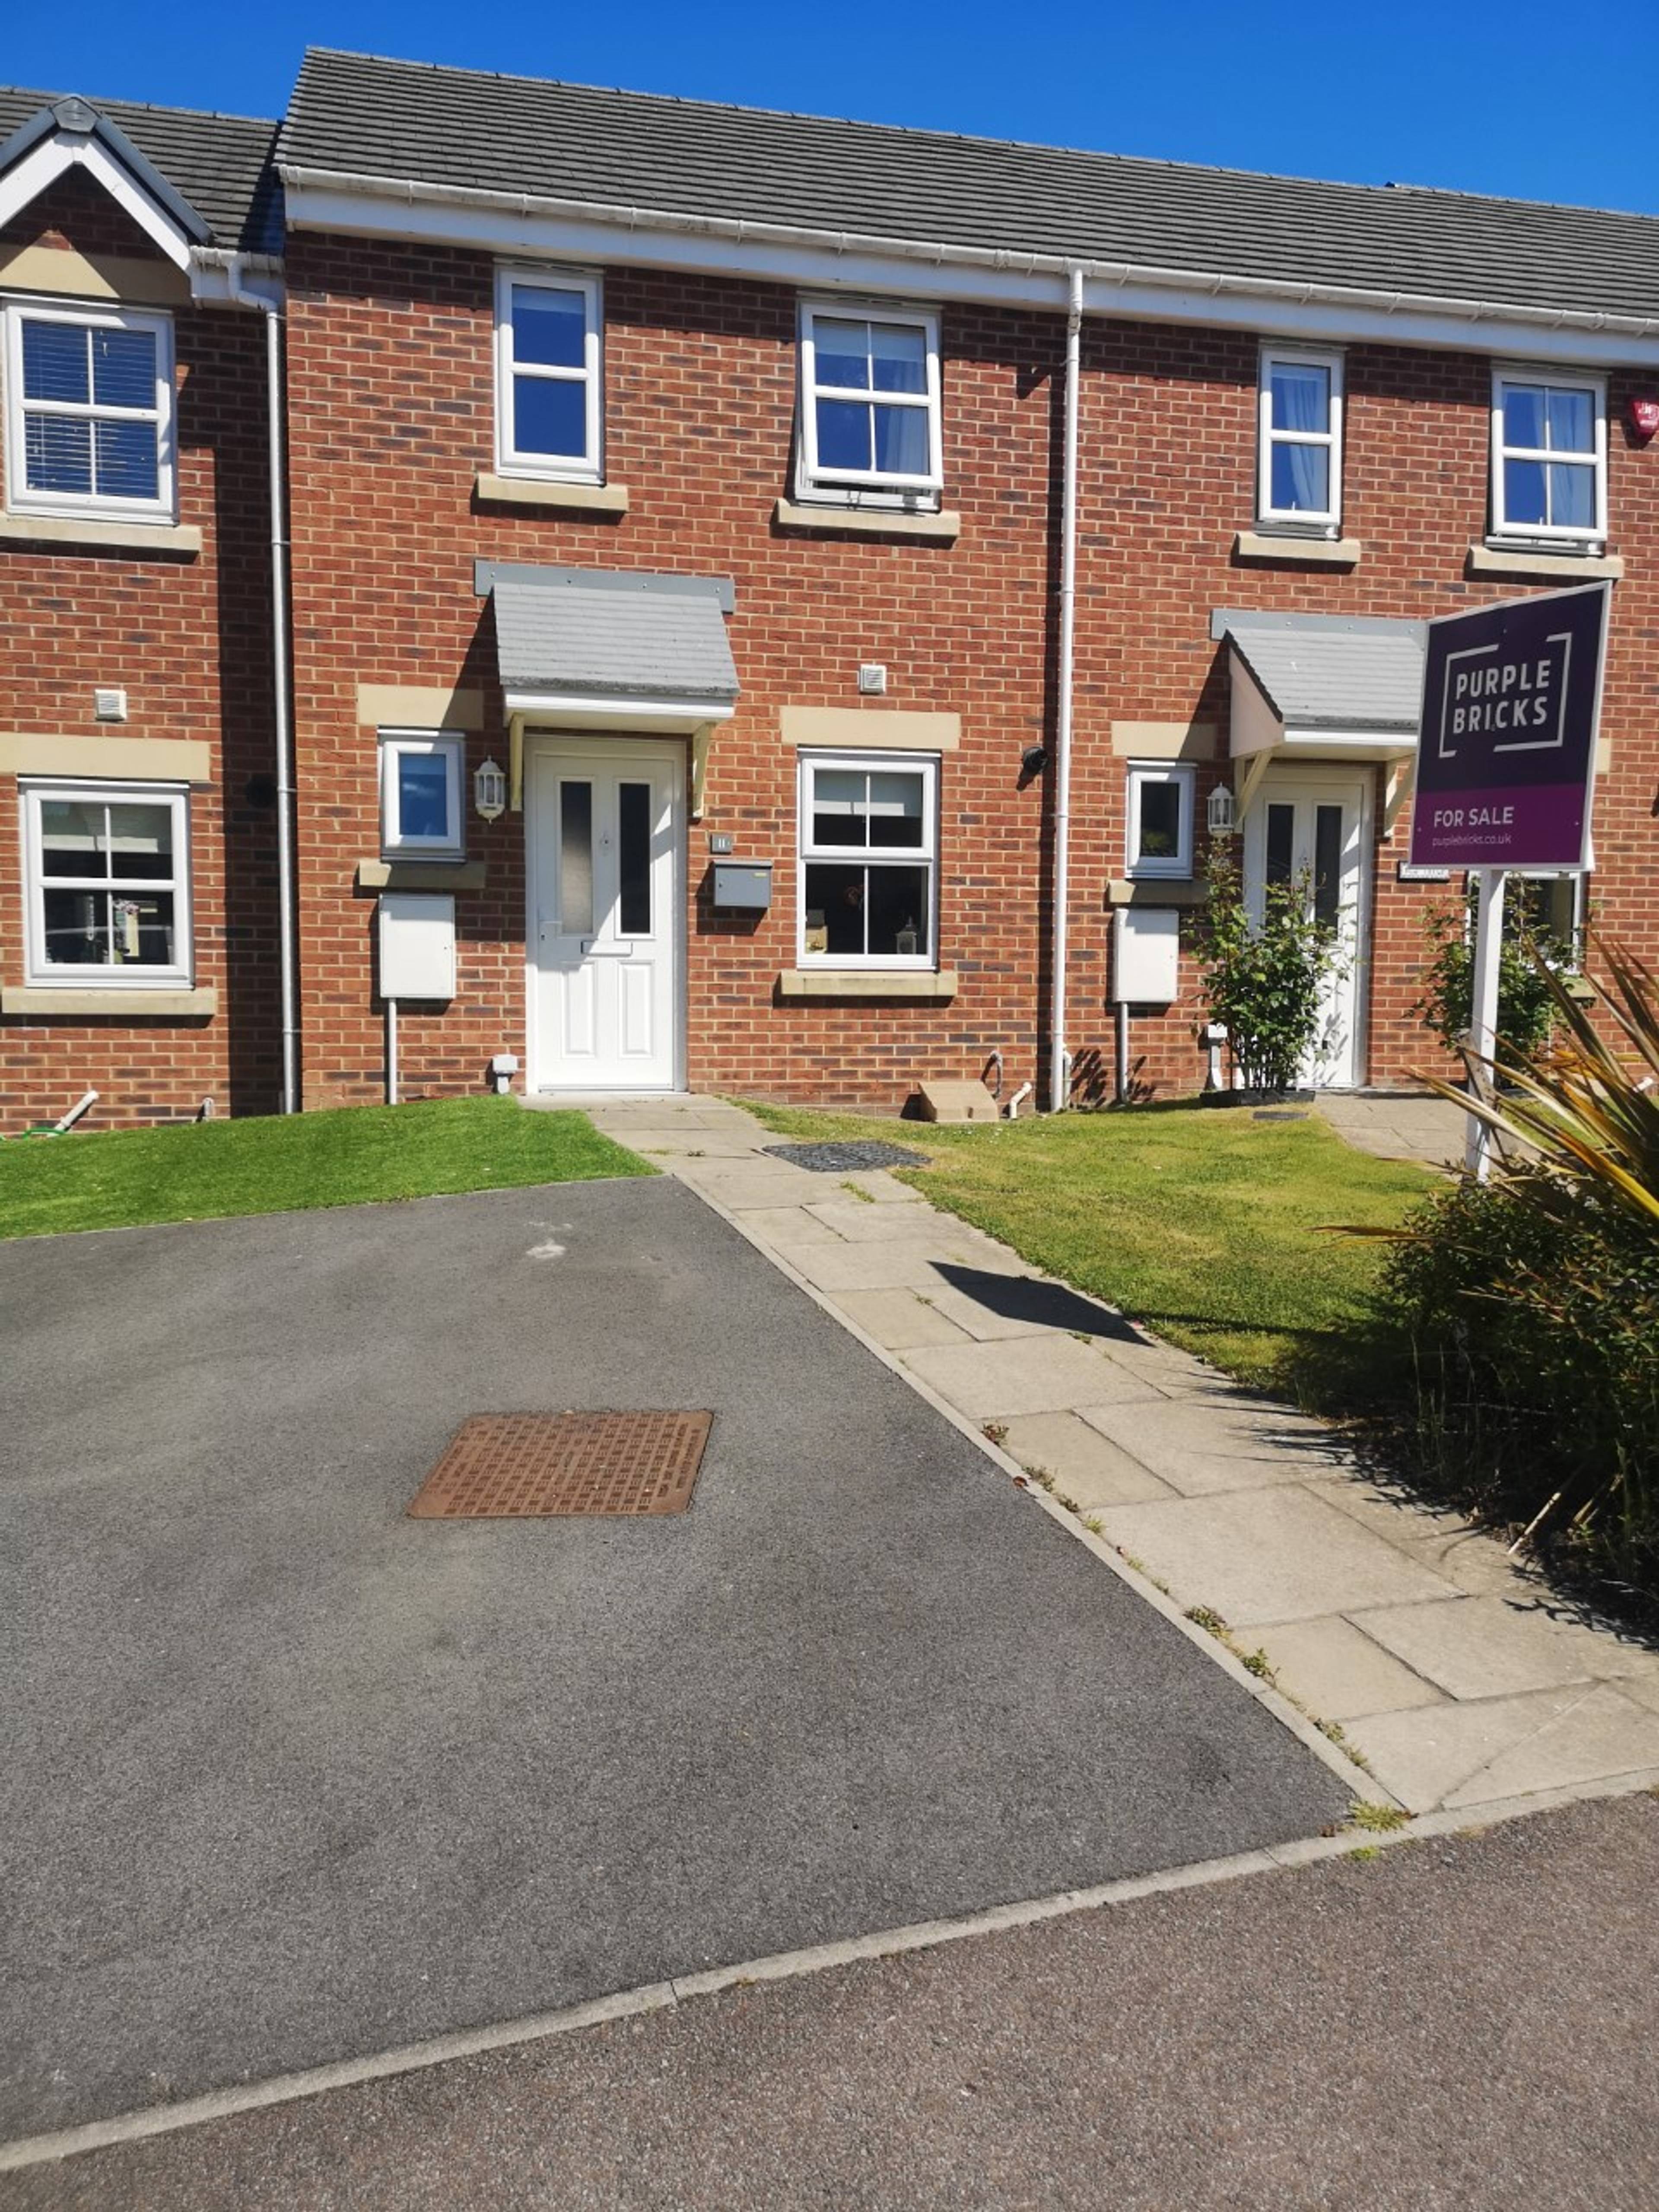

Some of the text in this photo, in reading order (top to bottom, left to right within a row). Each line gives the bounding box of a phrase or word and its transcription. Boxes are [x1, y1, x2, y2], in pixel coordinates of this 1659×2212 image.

[1456, 659, 1551, 701] PURPLE
[1453, 696, 1548, 734] BRICKS
[1434, 806, 1515, 828] FOR SALE
[1432, 833, 1512, 849] purplebricks.co.uk
